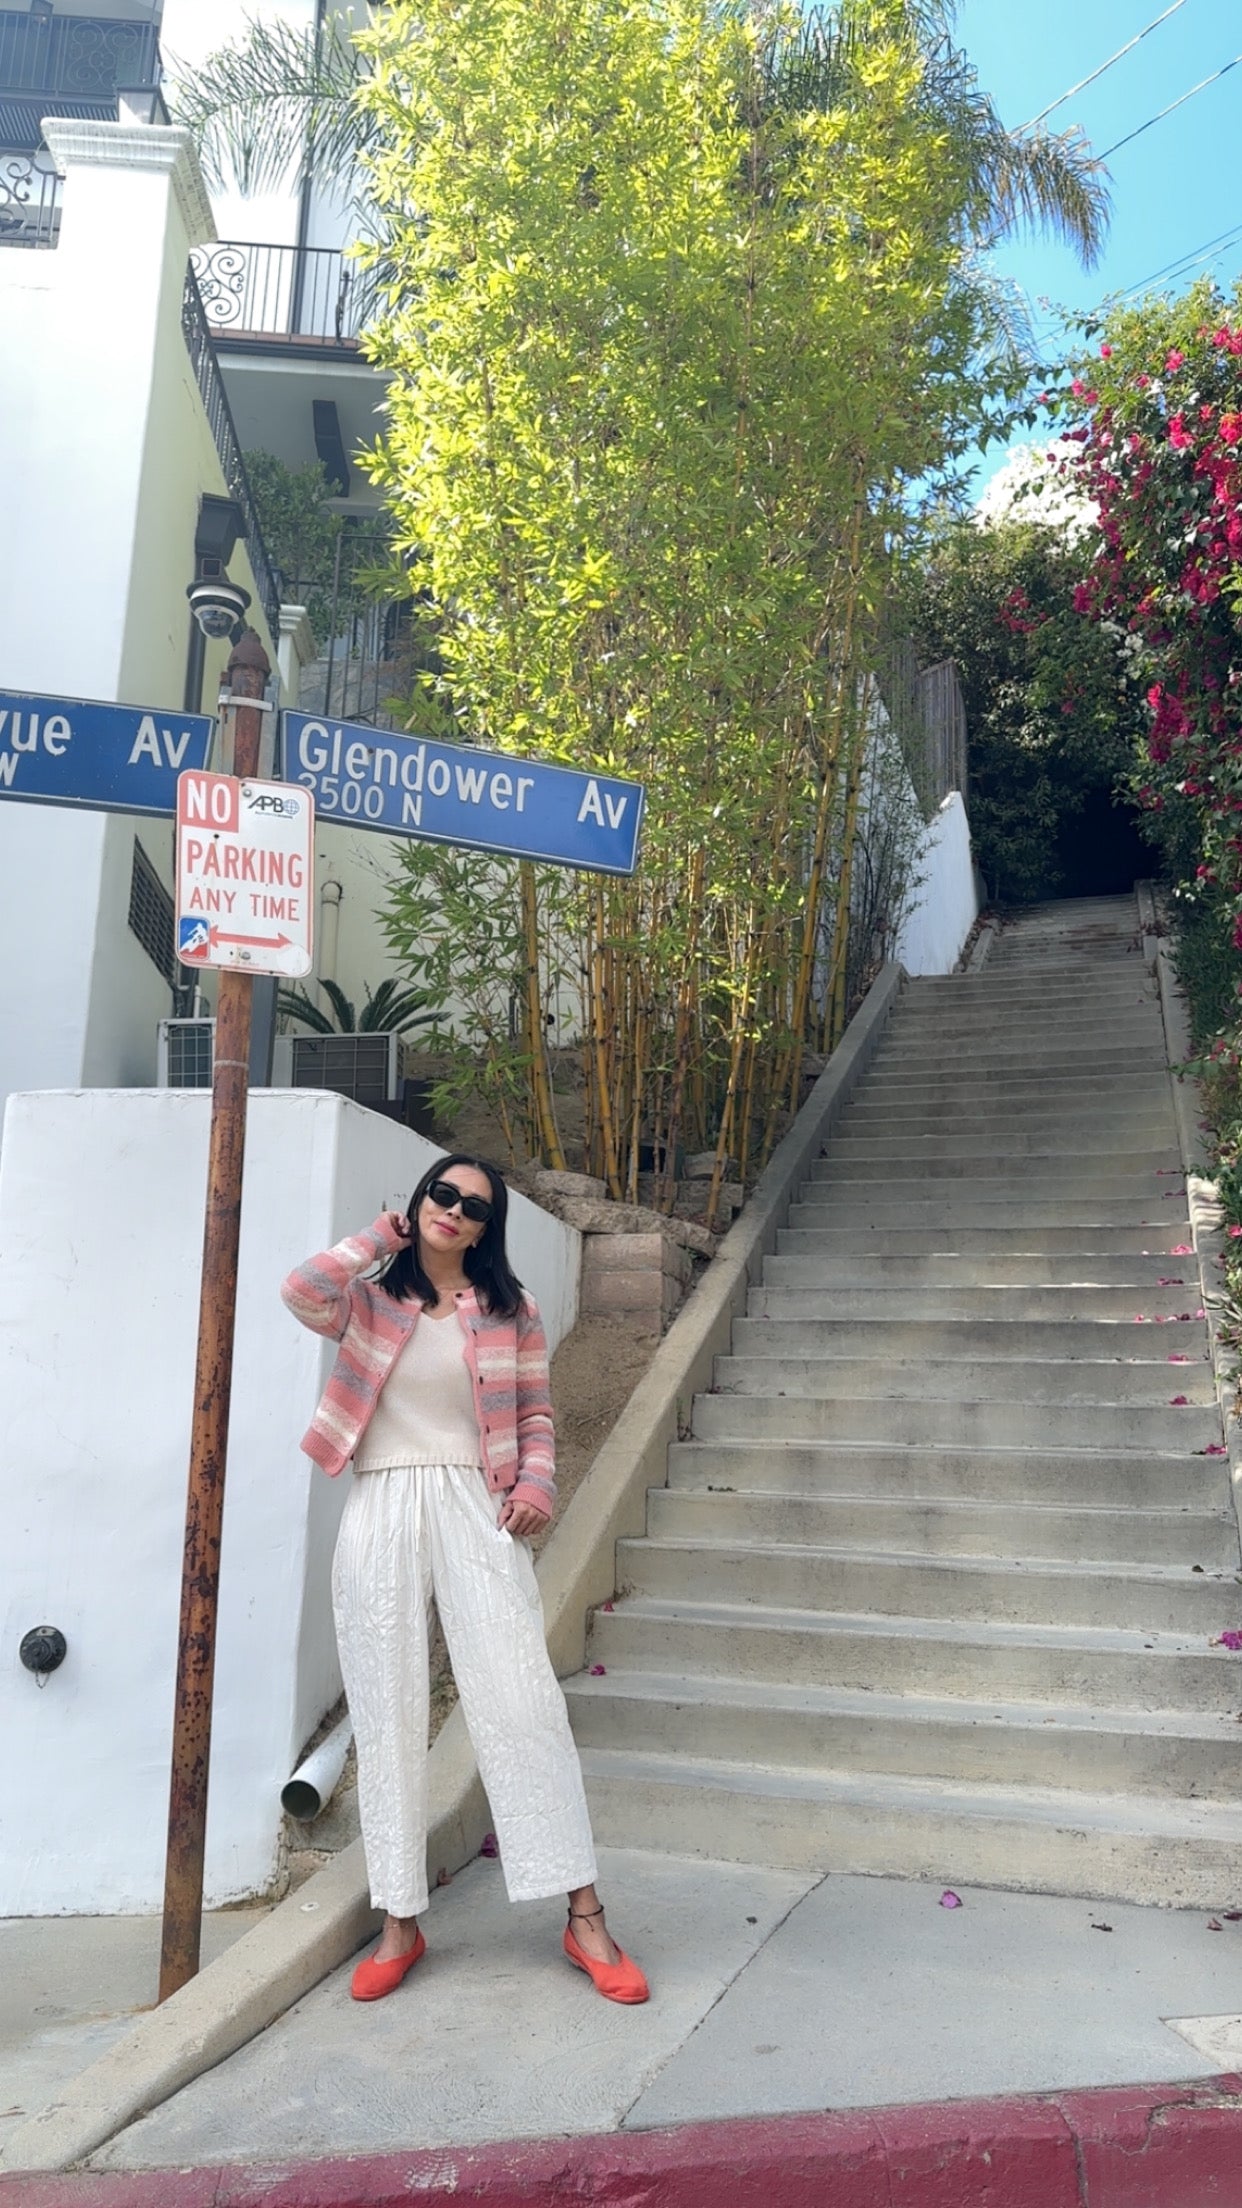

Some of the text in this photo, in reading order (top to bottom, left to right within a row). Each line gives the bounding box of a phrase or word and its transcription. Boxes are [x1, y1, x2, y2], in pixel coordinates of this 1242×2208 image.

[128, 716, 190, 768] Av
[299, 722, 628, 829] Glendower Av
[187, 779, 232, 824] NO
[401, 792, 422, 826] N
[187, 839, 303, 888] PARKING
[189, 888, 300, 921] ANY TIME
